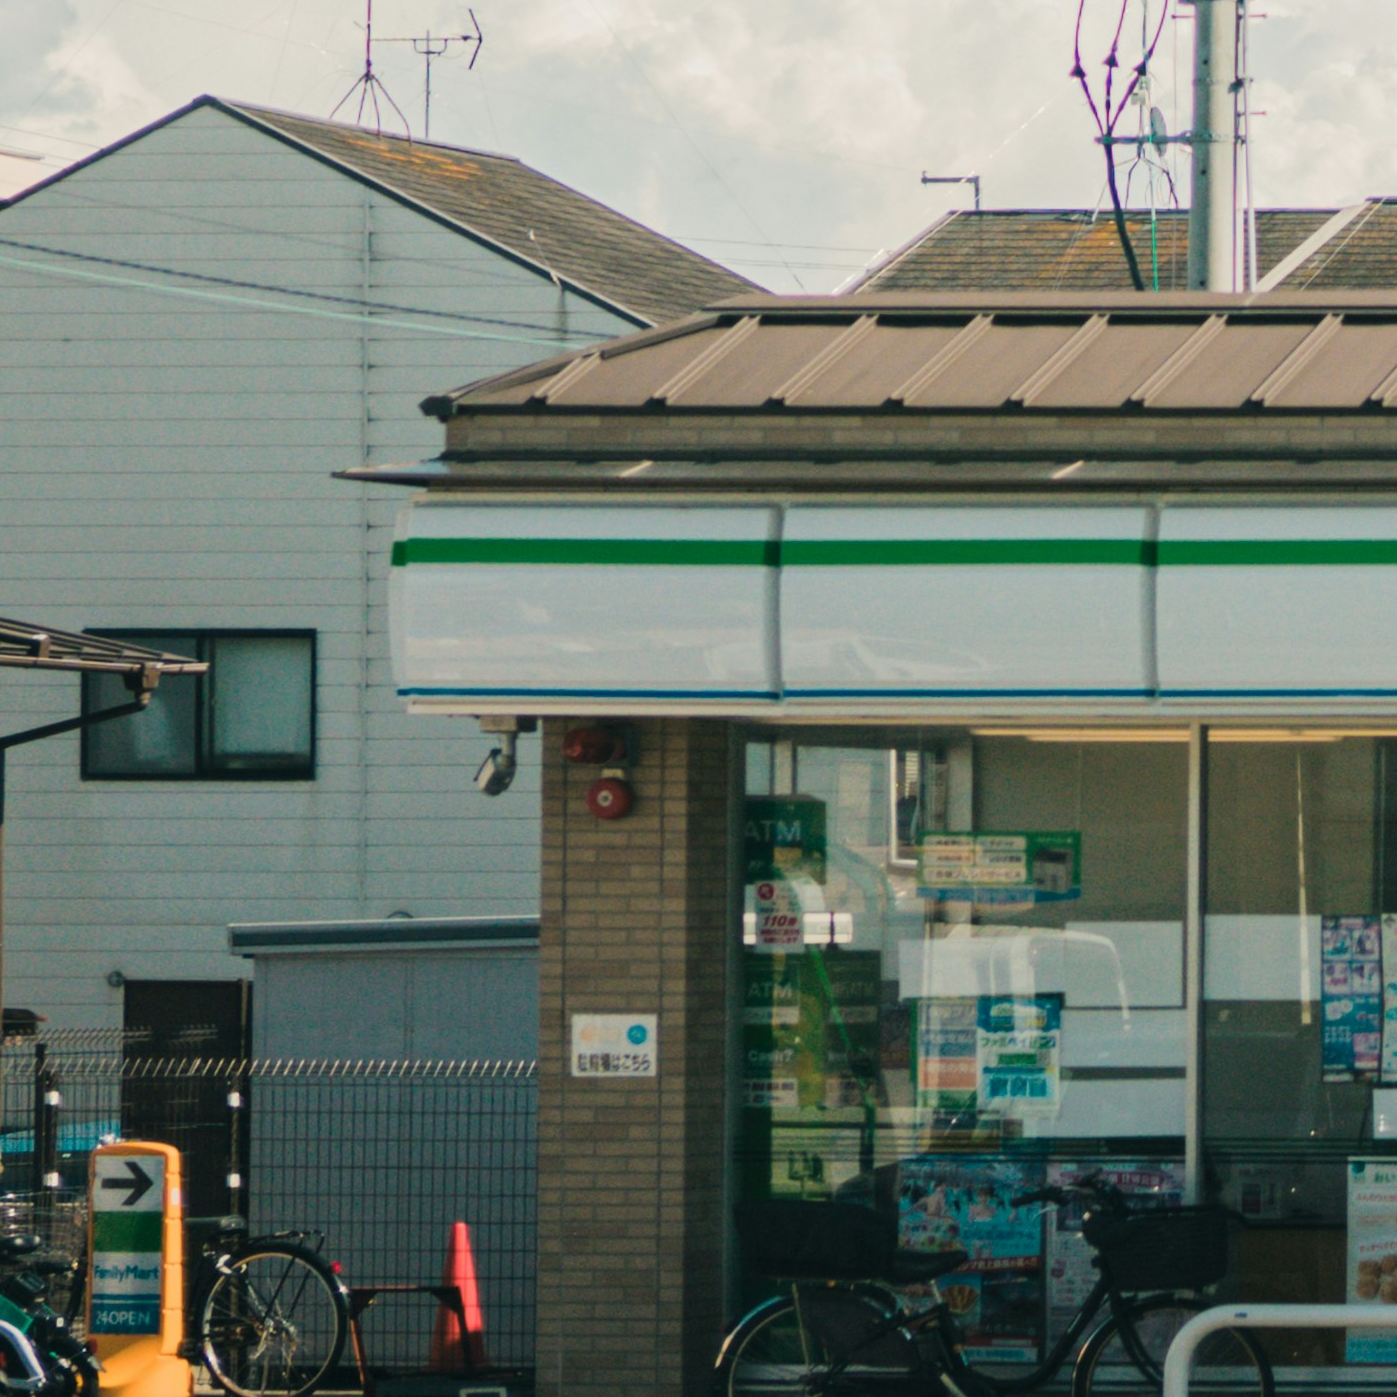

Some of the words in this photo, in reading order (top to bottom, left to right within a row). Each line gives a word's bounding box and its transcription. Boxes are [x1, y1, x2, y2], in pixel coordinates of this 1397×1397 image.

[744, 820, 802, 842] ATM
[748, 982, 794, 999] ATM
[95, 1265, 159, 1283] FamilyMart
